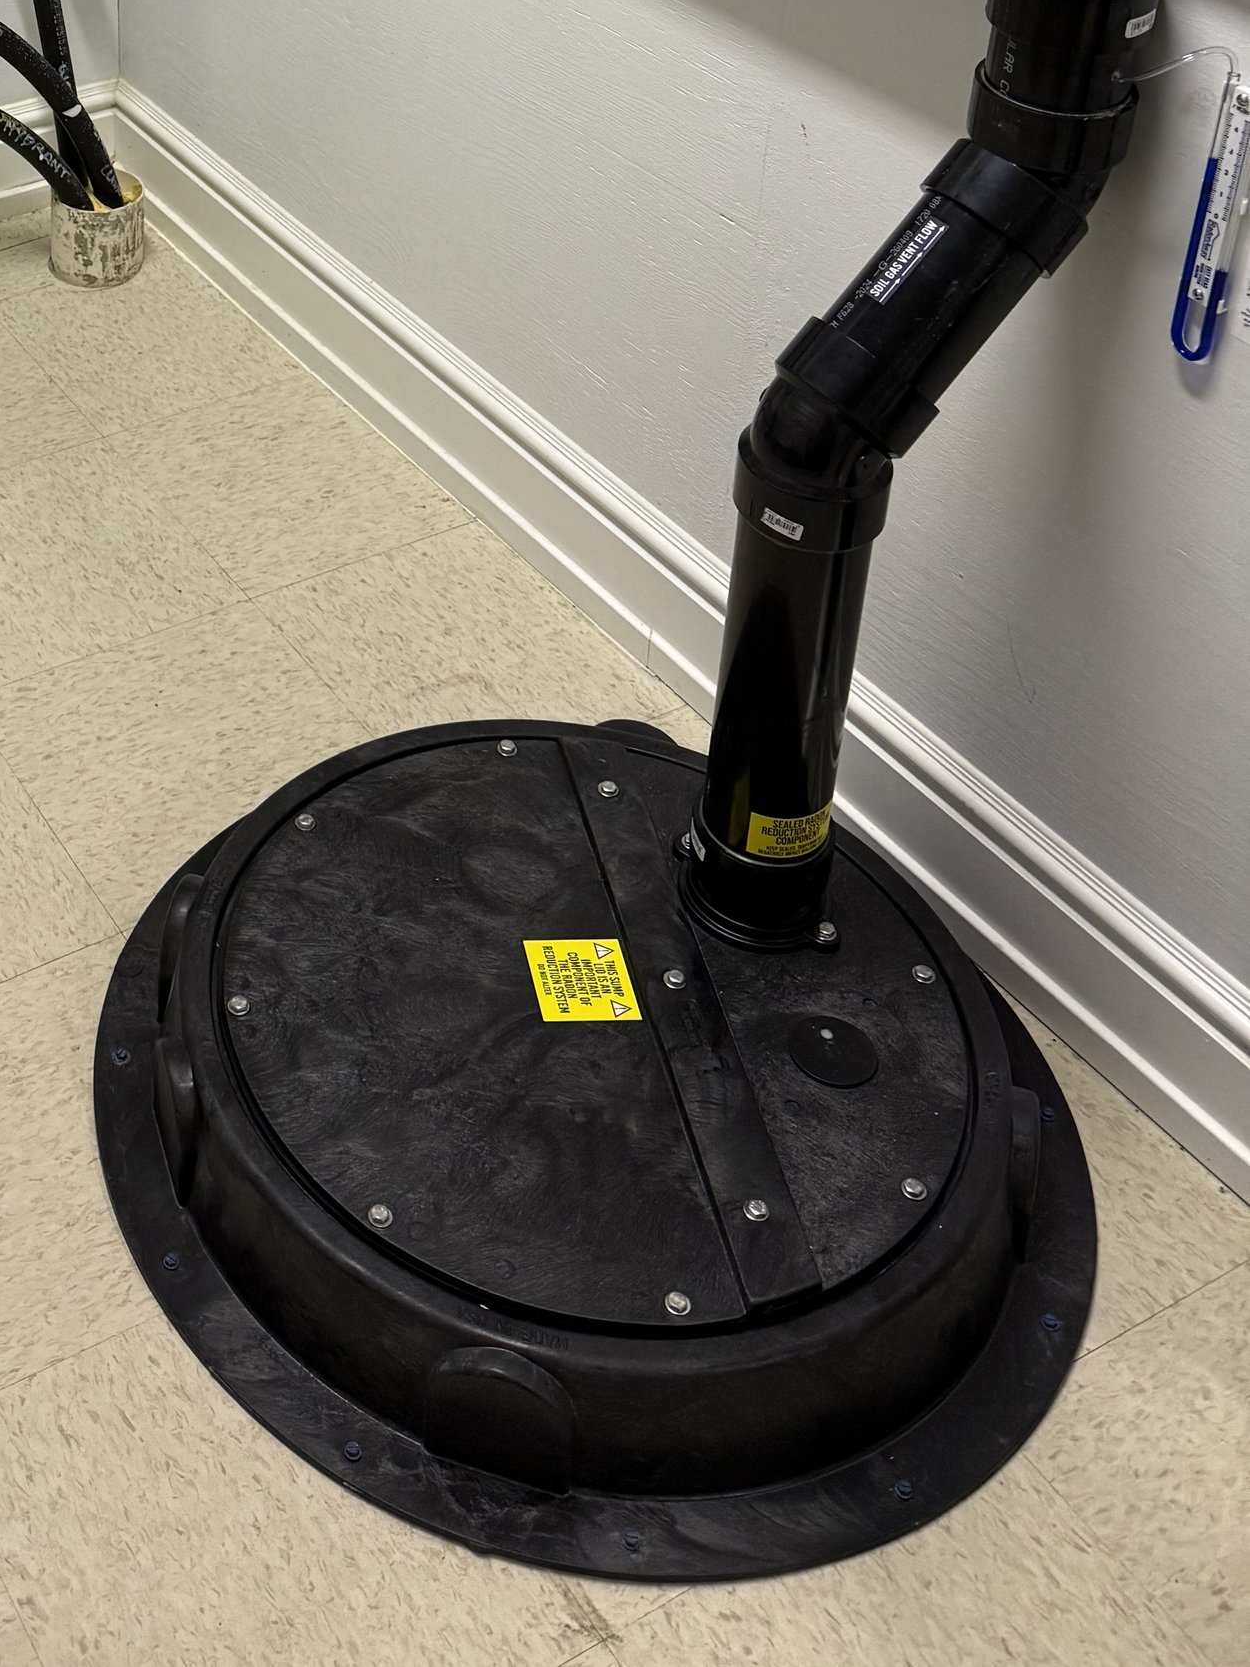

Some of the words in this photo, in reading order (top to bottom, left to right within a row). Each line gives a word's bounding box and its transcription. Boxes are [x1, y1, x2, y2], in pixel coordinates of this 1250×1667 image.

[870, 278, 890, 296] SOIL
[885, 261, 903, 279] GAS
[897, 241, 919, 264] VENT
[914, 220, 937, 244] FLOW
[762, 825, 807, 836] REDUCTION
[773, 819, 803, 829] SEALED
[558, 959, 571, 973] THE
[593, 963, 606, 974] LID
[604, 960, 618, 976] THIS
[542, 945, 562, 985] REDUCTION
[553, 986, 570, 1013] SYSTEM
[562, 974, 578, 999] RADON
[567, 952, 590, 995] COMPONENT
[580, 997, 592, 1006] OF
[581, 959, 602, 999] IMPORTANT
[598, 975, 608, 983] IS
[610, 977, 624, 997] SUMP
[600, 984, 612, 994] AN
